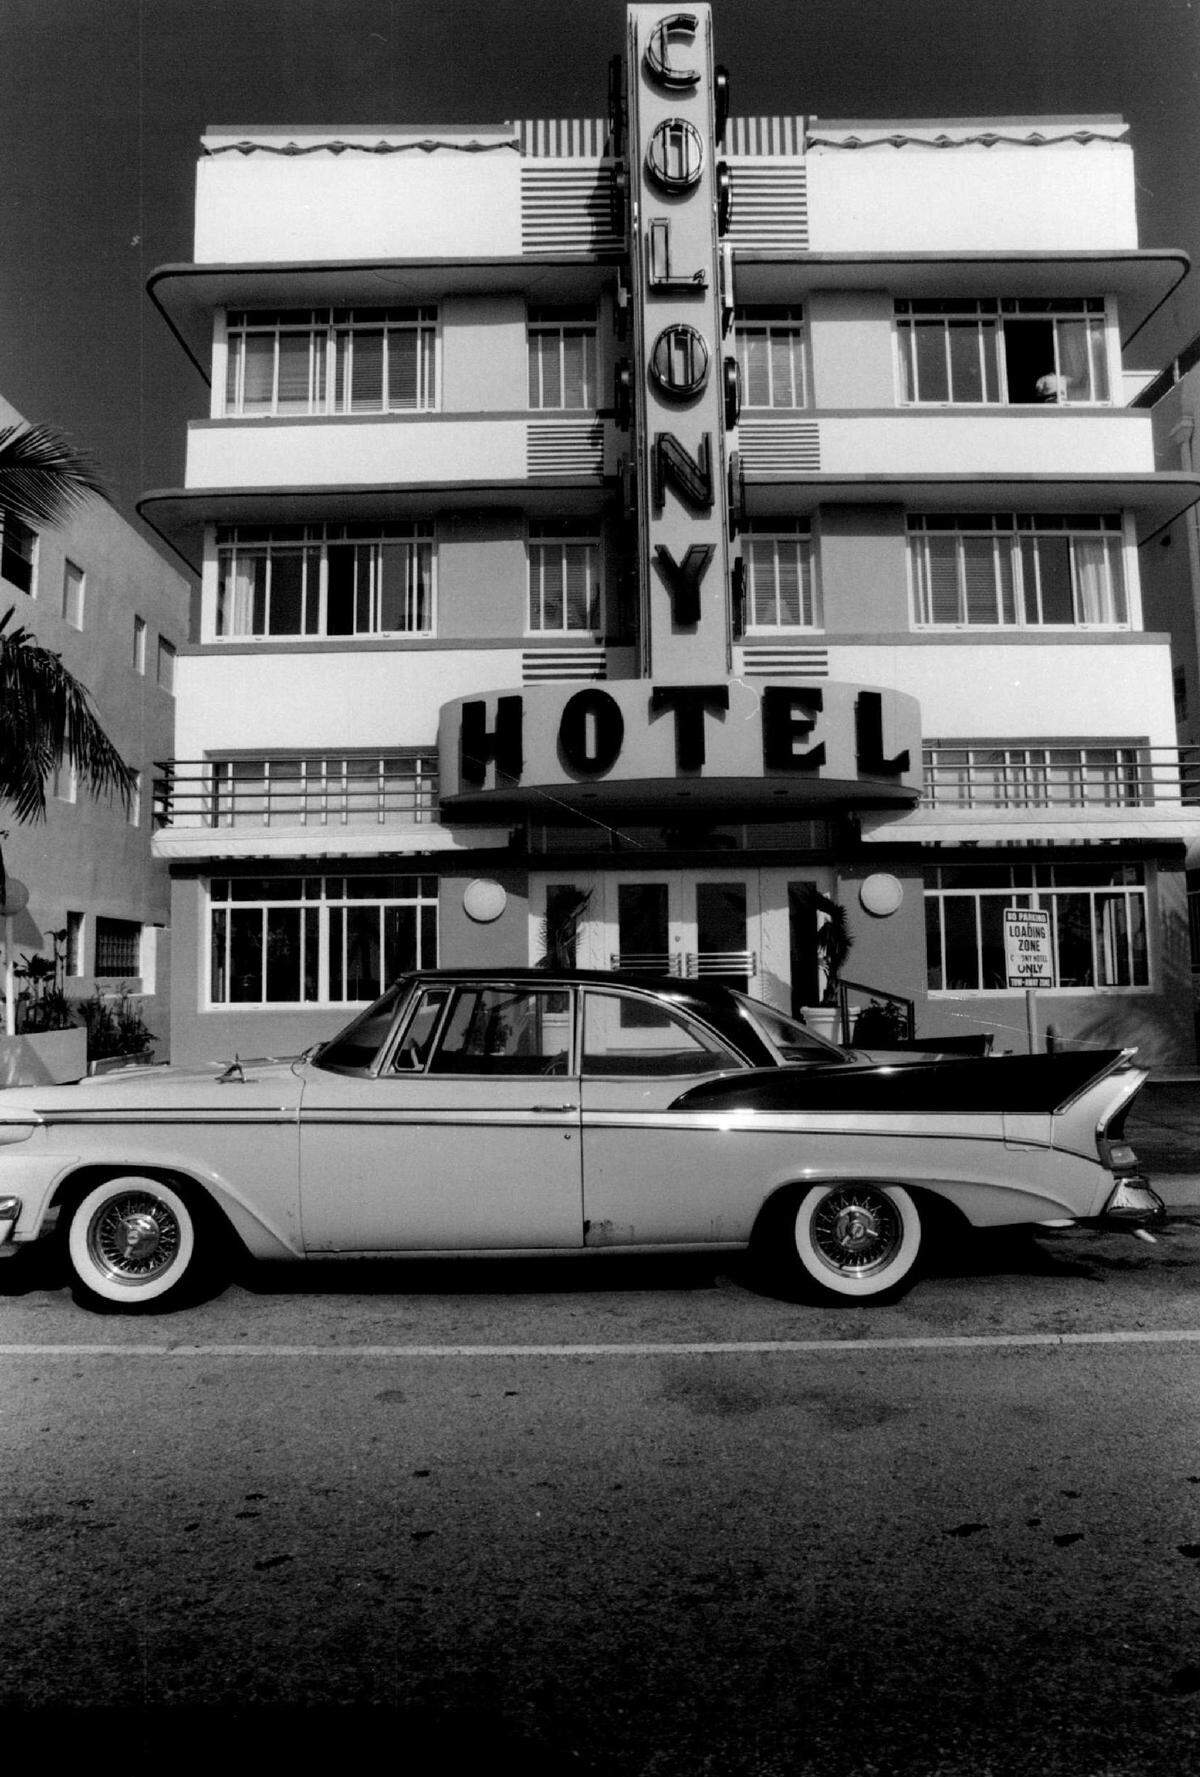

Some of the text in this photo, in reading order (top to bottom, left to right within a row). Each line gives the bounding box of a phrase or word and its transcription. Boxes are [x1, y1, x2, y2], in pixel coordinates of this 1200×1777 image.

[645, 12, 716, 626] COLONY
[460, 684, 910, 787] HOTEL
[1018, 913, 1047, 922] PARKING
[1009, 925, 1046, 939] LOADING
[1018, 940, 1041, 952] ZONE
[1017, 964, 1043, 974] ONLY
